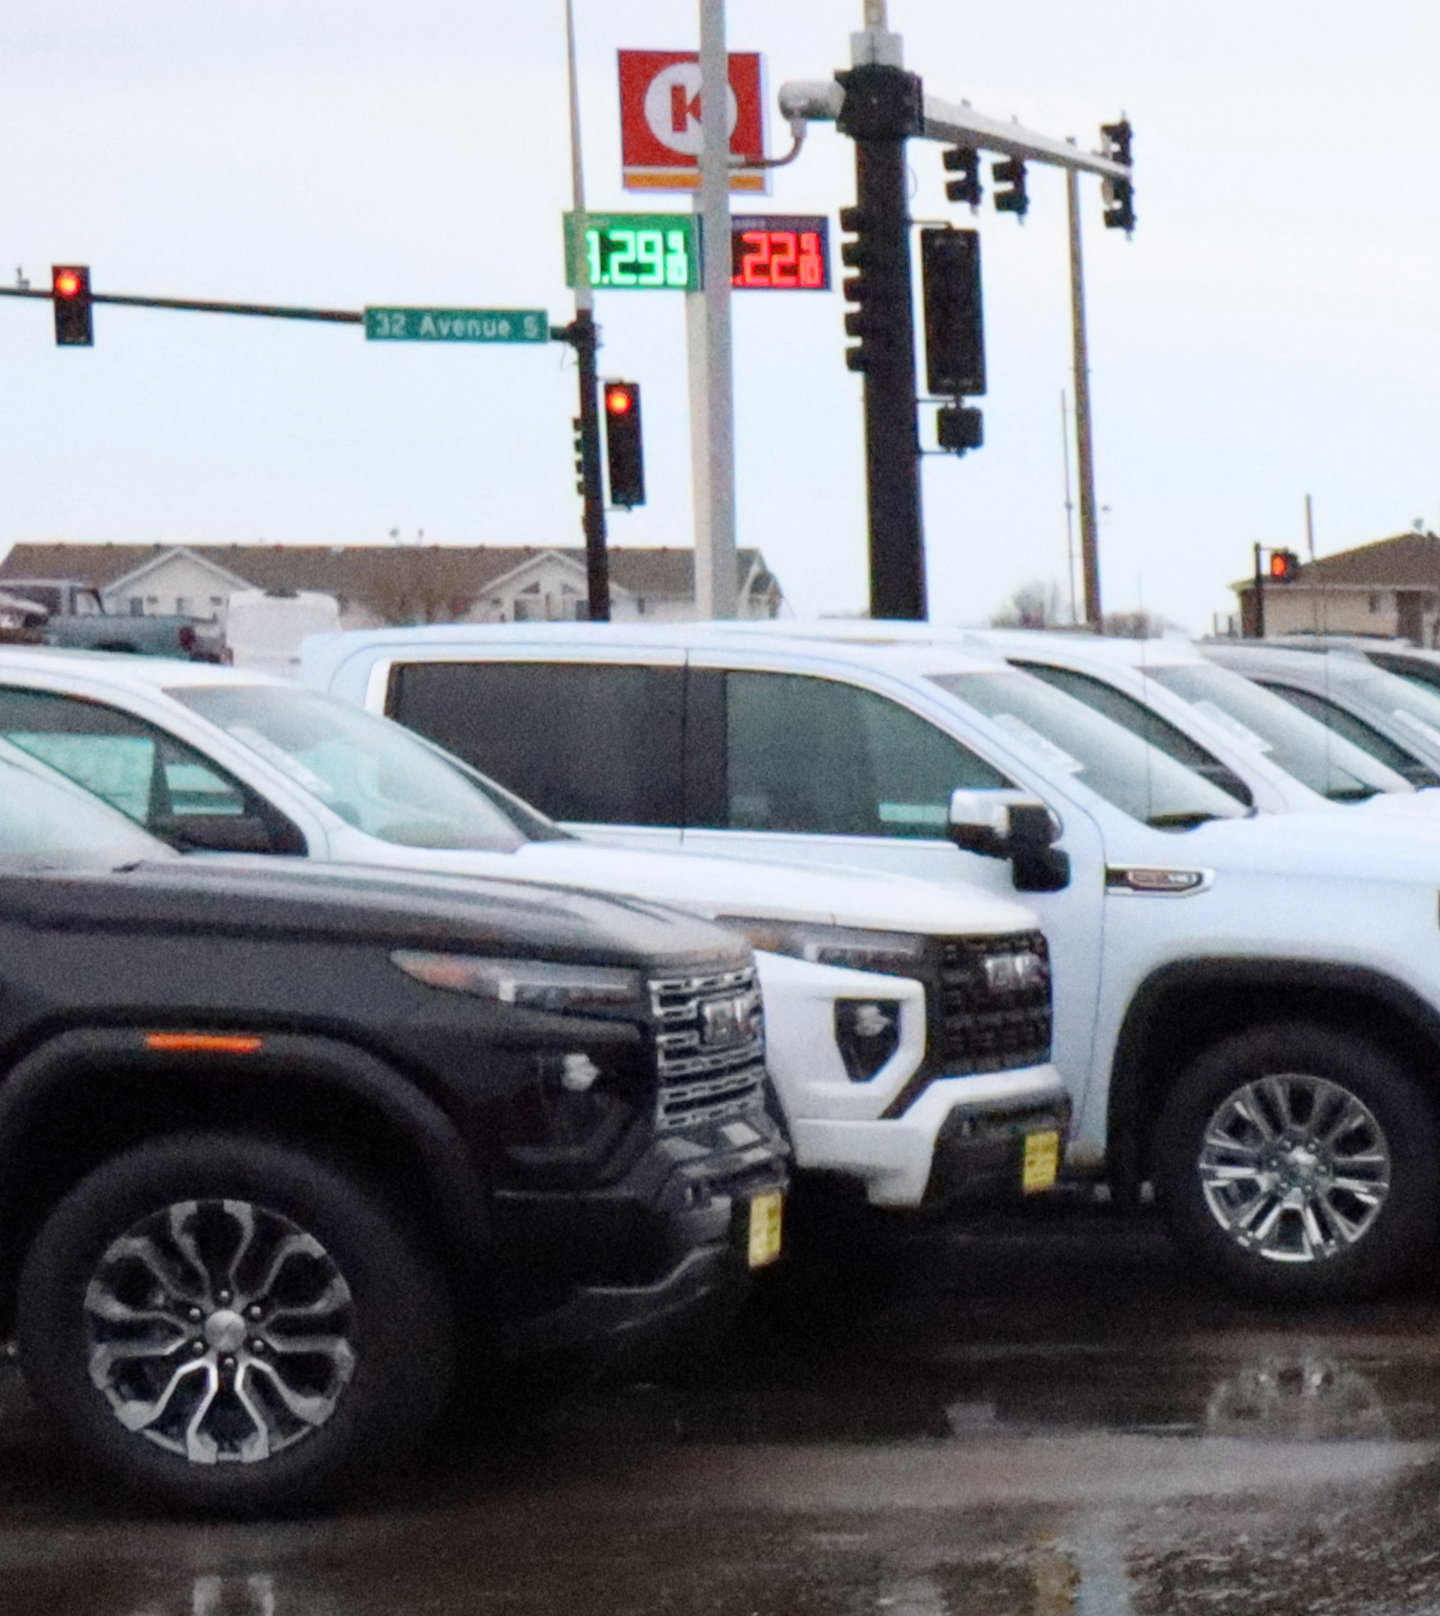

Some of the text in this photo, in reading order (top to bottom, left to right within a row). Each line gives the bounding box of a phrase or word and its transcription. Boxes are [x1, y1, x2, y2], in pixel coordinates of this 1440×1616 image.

[375, 312, 540, 339] 32 Avenue S
